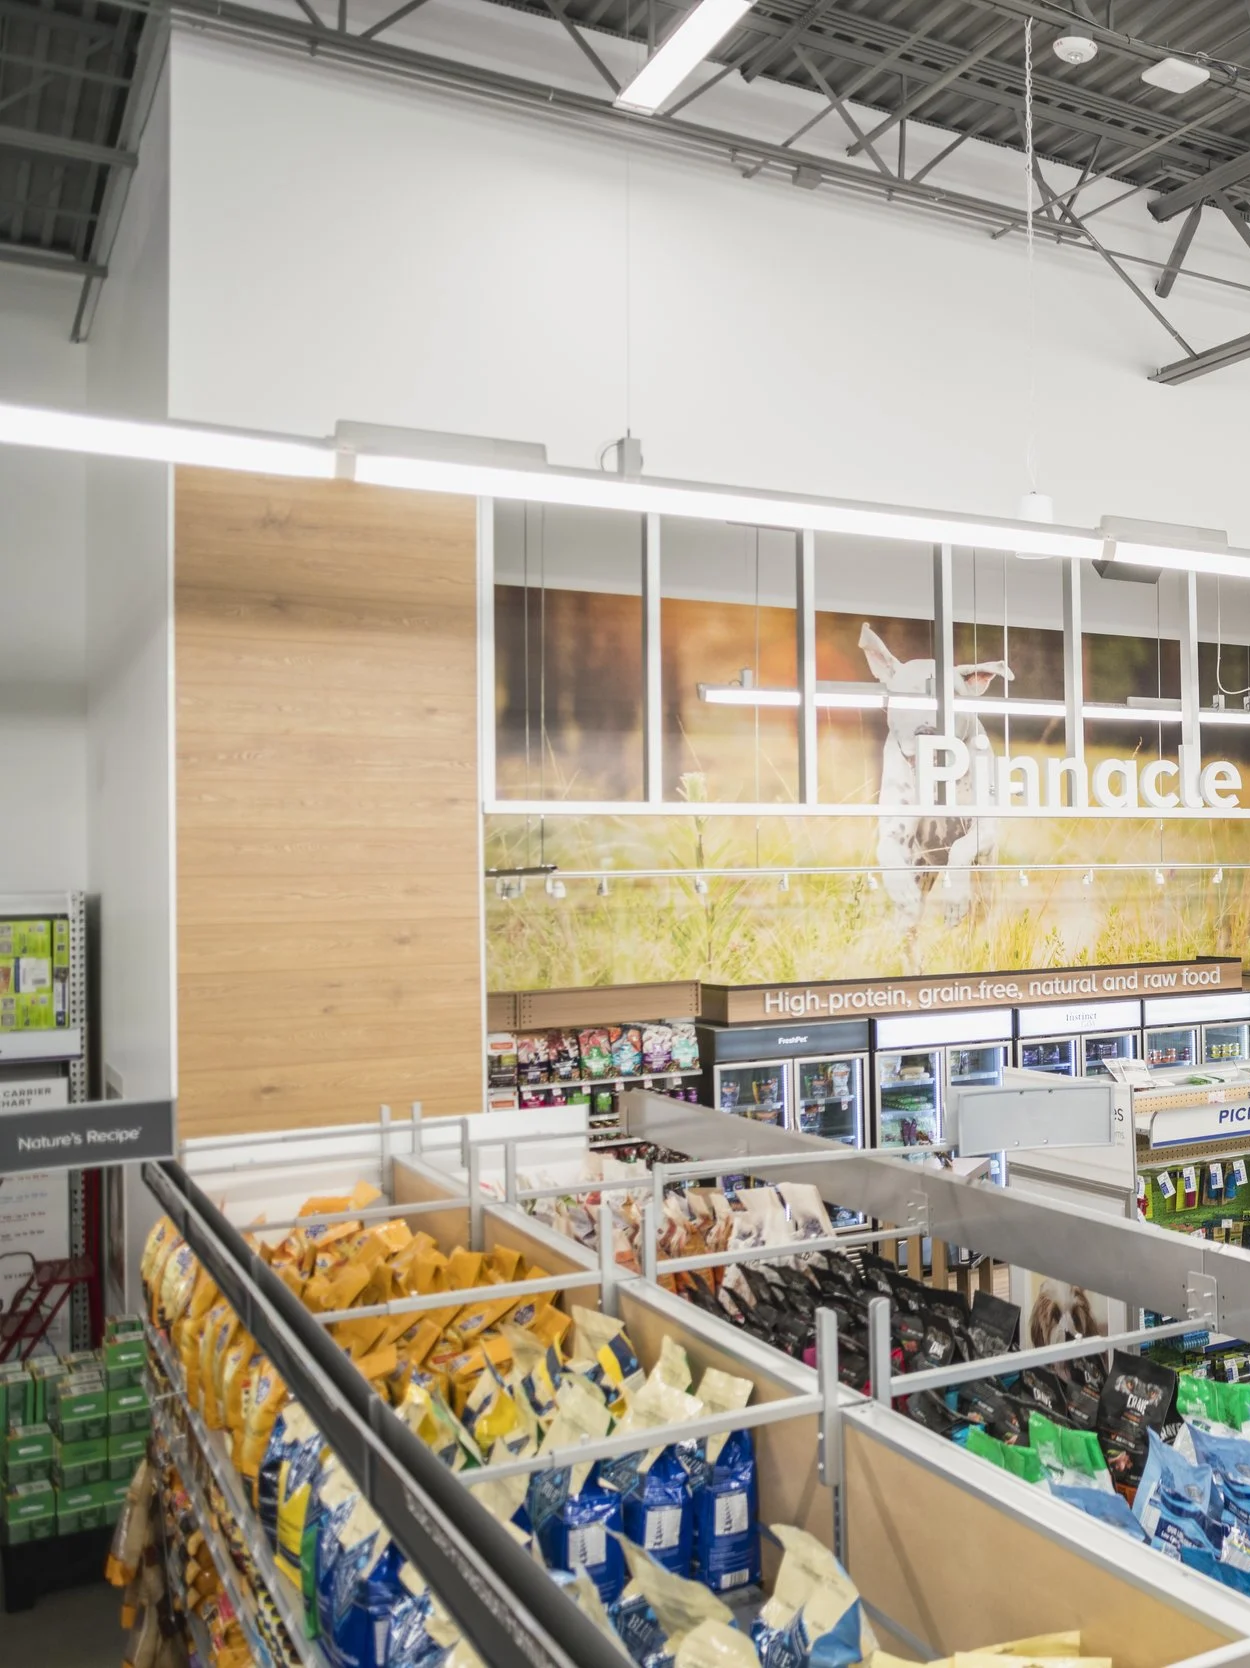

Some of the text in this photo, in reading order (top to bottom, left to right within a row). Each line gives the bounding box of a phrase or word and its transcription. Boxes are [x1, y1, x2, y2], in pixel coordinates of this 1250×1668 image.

[915, 734, 1243, 809] Pinnacle
[764, 966, 1221, 1016] High-protein, grain-free, natural and raw food
[1, 1098, 32, 1108] HART
[3, 1087, 52, 1098] CARRIER
[18, 1127, 140, 1151] Nature's Recipe
